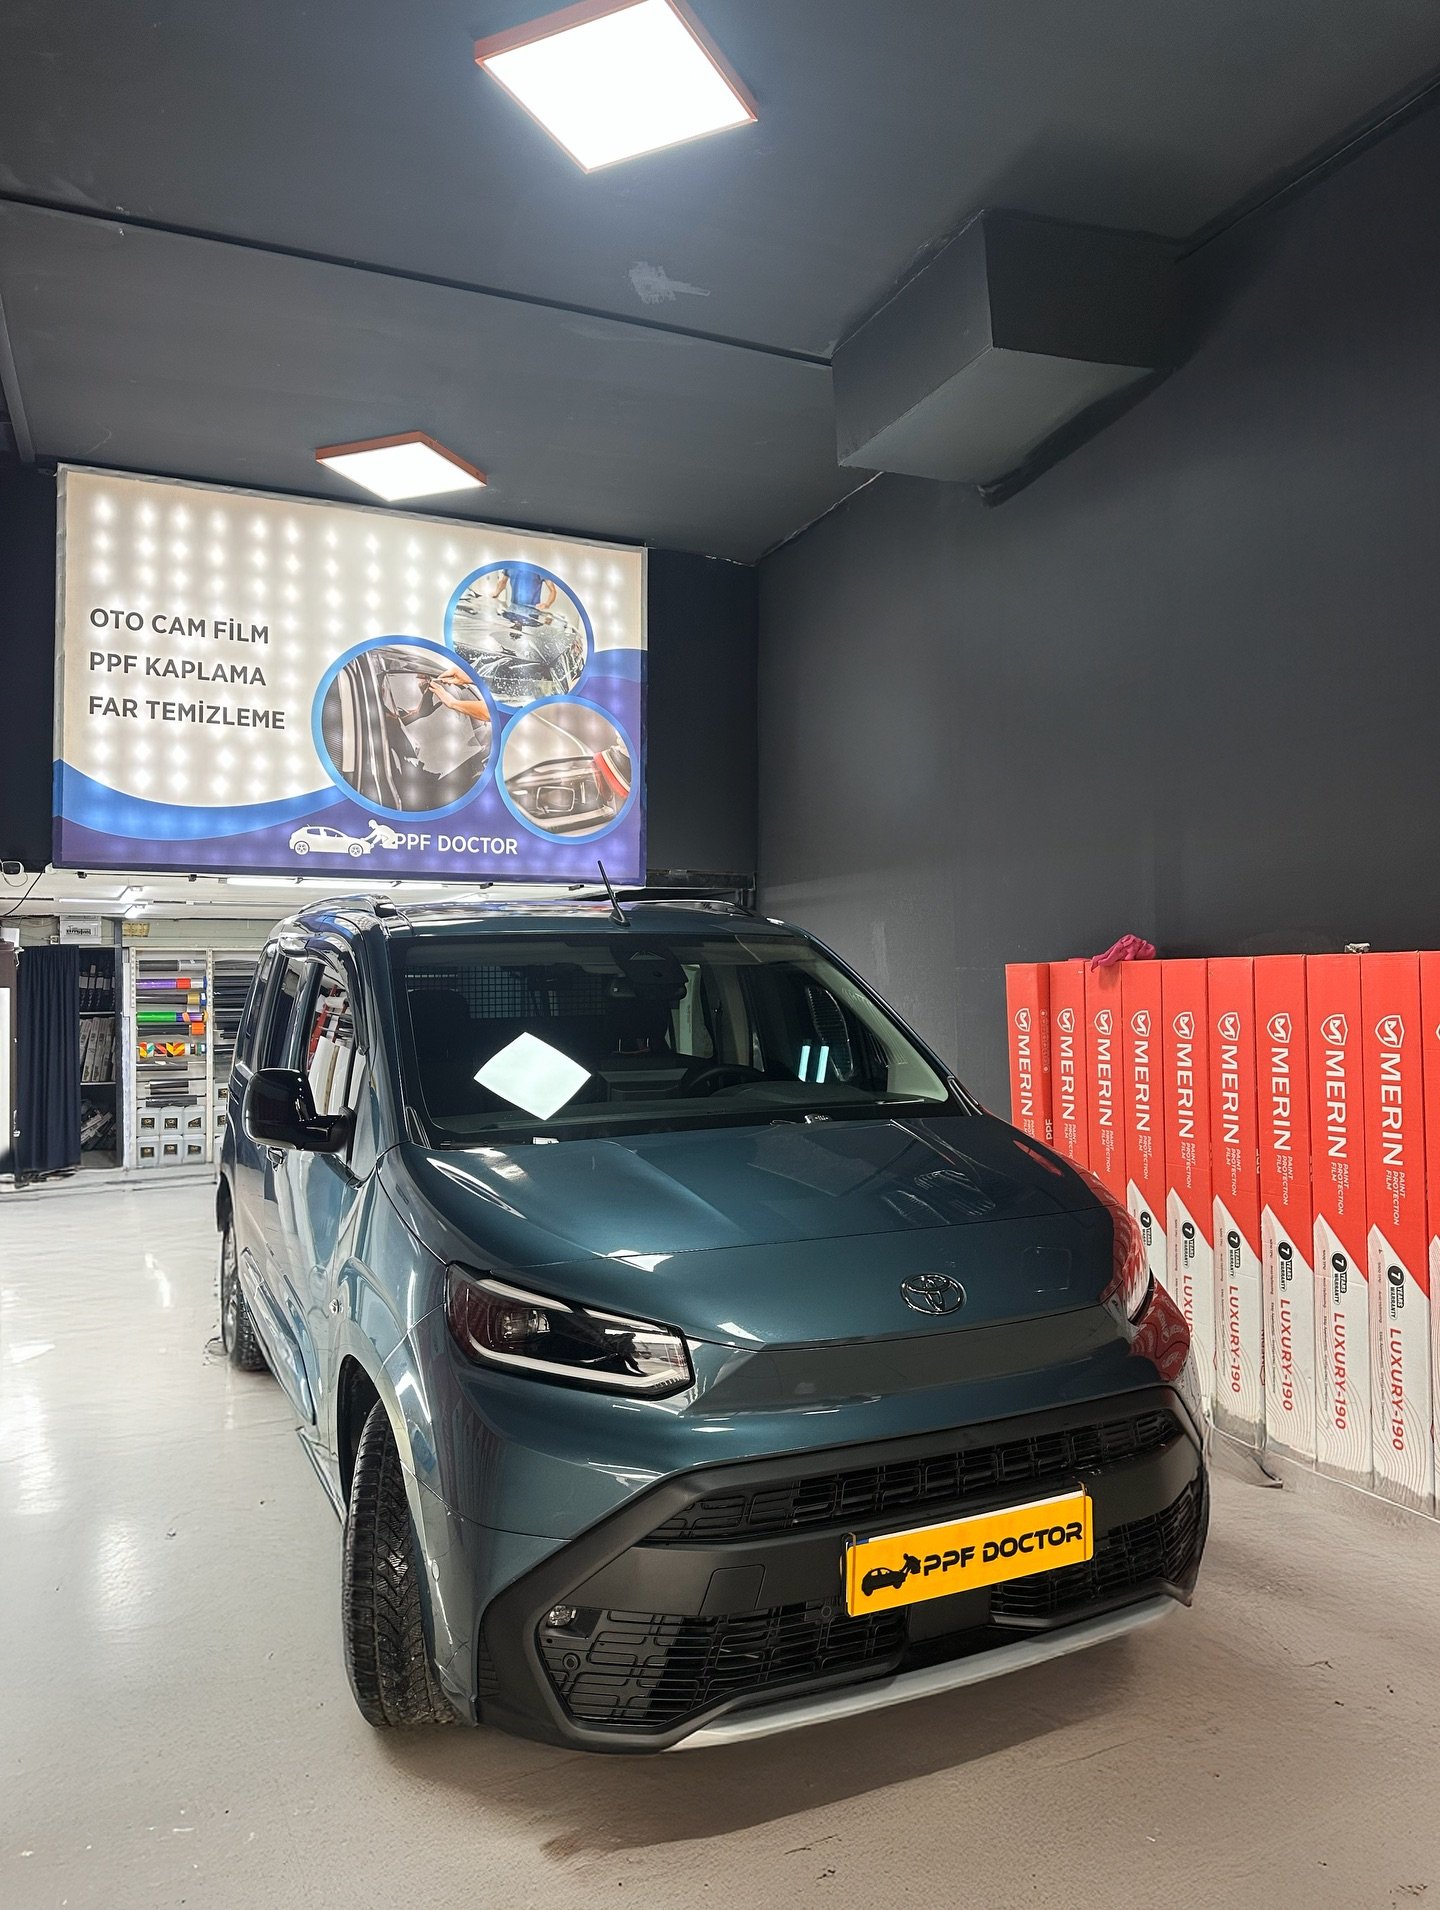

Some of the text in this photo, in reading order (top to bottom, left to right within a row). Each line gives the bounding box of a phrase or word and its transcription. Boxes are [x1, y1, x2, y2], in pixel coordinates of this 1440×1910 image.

[90, 608, 143, 632] OTO
[151, 613, 207, 639] CAM
[89, 696, 137, 718] FAR
[90, 652, 266, 685] PPF KAPLAMA
[394, 832, 518, 856] PPF DOCTOR
[1018, 1035, 1034, 1116] MERIN
[1060, 1036, 1075, 1120] MERIN
[1097, 1038, 1113, 1126] MERIN
[1134, 1040, 1150, 1131] MERIN
[1177, 1043, 1194, 1138] MERIN
[1221, 1045, 1240, 1144] MERIN
[1271, 1047, 1291, 1150] MERIN
[1325, 1050, 1347, 1158] MERIN
[1380, 1052, 1404, 1165] MERIN
[1392, 1170, 1400, 1226] PROTECTION
[1183, 1275, 1194, 1338] LUXU
[1230, 1285, 1241, 1393] LUXURY-190
[1280, 1298, 1293, 1411] LUXURY-190
[1334, 1312, 1346, 1430] LUXURY-190
[1390, 1328, 1404, 1451] LUXURY-190
[924, 1521, 1082, 1576] PPF DOCTOR
